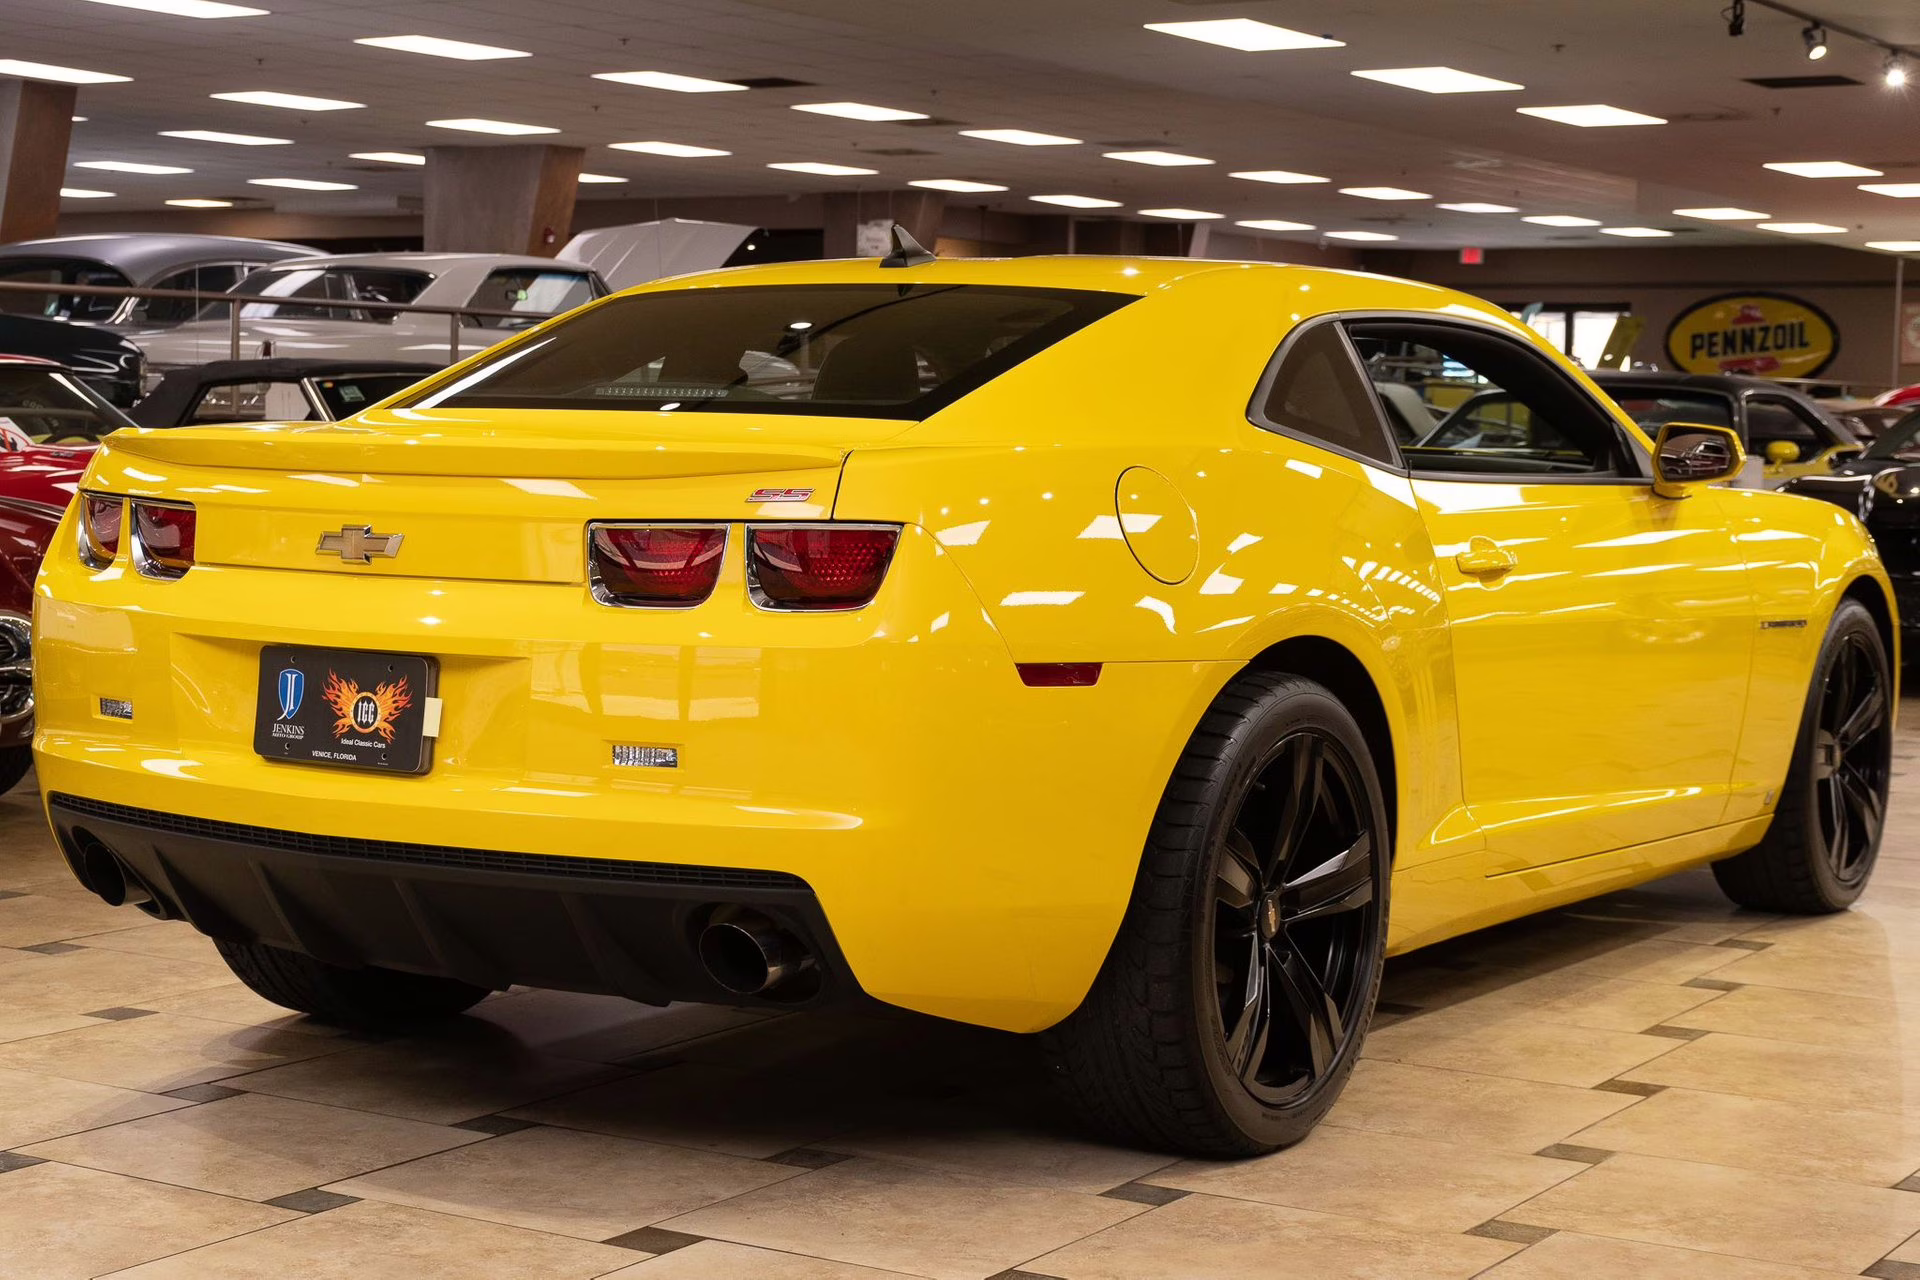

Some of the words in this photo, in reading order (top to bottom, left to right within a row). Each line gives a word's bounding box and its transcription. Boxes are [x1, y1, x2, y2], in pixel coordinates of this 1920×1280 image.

[1690, 321, 1810, 360] PENNZOIL
[745, 488, 816, 503] SS
[272, 723, 305, 736] JENKINS
[341, 738, 354, 746] Ideal
[354, 739, 373, 748] Classic
[373, 741, 386, 749] Cars
[311, 750, 333, 759] VENICE,
[333, 752, 357, 761] FLORIDA
